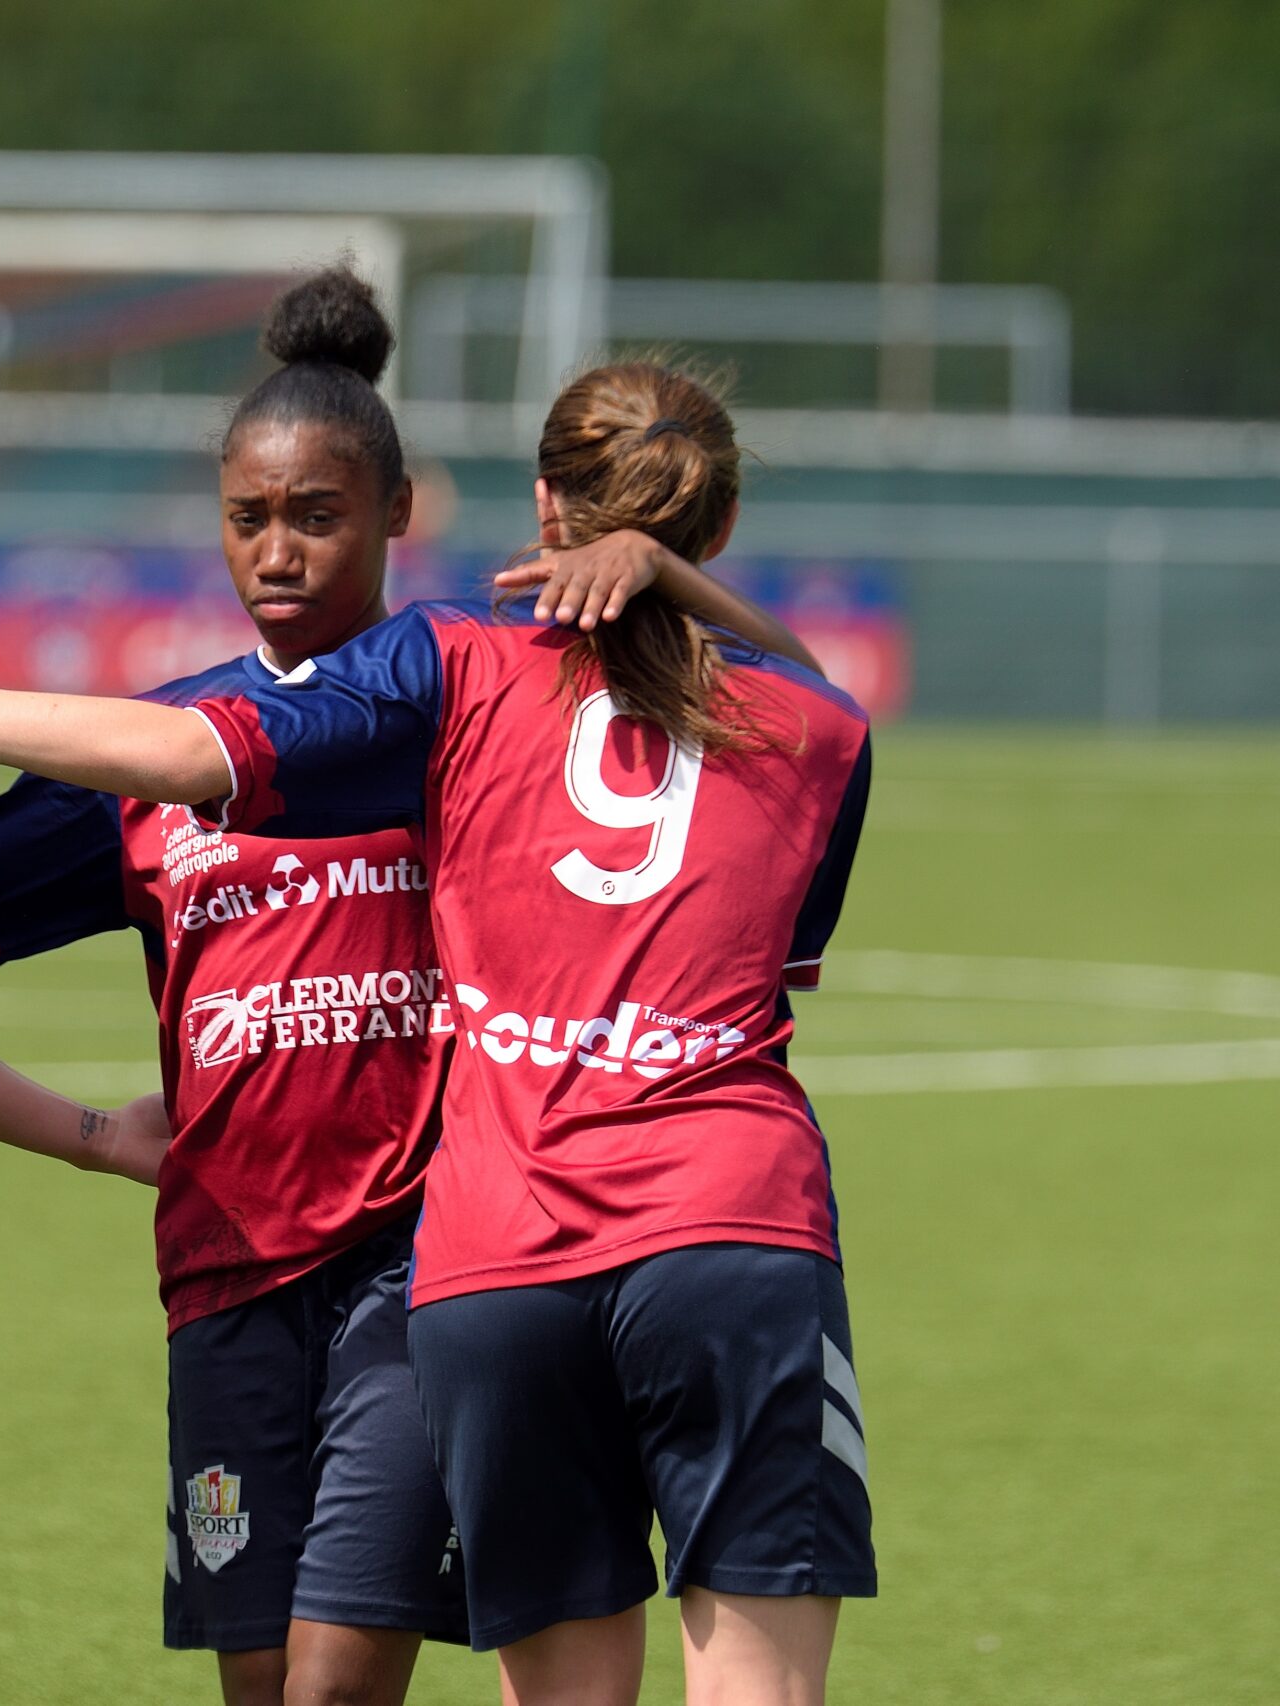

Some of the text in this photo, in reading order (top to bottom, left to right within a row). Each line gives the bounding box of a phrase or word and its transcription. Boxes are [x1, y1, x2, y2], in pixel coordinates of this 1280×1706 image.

[550, 688, 705, 905] 9
[245, 967, 449, 1019] CLERMON
[643, 1005, 726, 1031] Transpor
